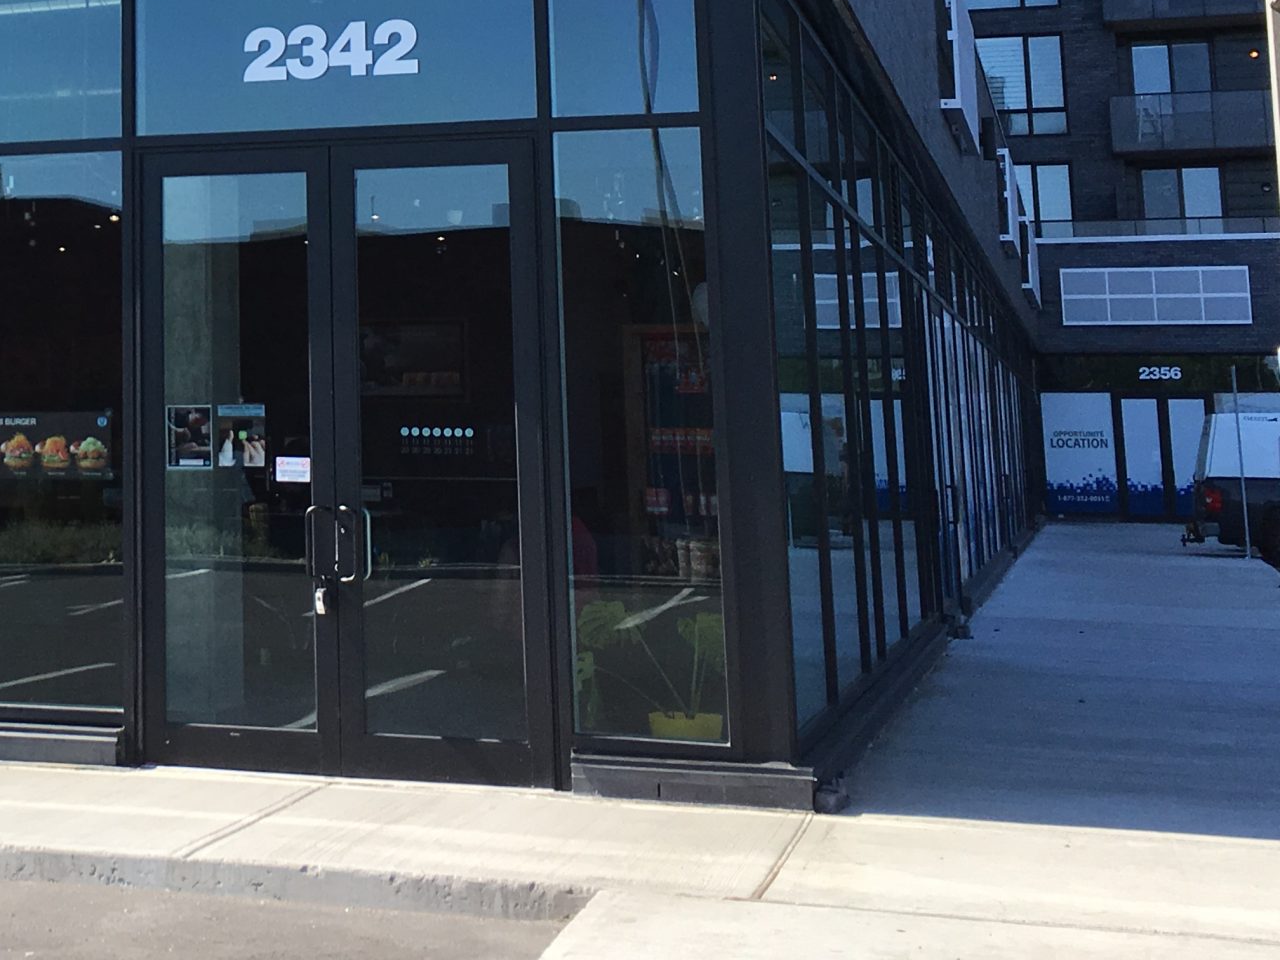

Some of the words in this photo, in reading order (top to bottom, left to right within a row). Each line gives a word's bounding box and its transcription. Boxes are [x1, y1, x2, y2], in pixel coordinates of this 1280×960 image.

[243, 19, 419, 82] 2342
[1138, 366, 1182, 380] 2356
[4, 417, 37, 426] BURGER
[1050, 438, 1109, 449] LOCATION
